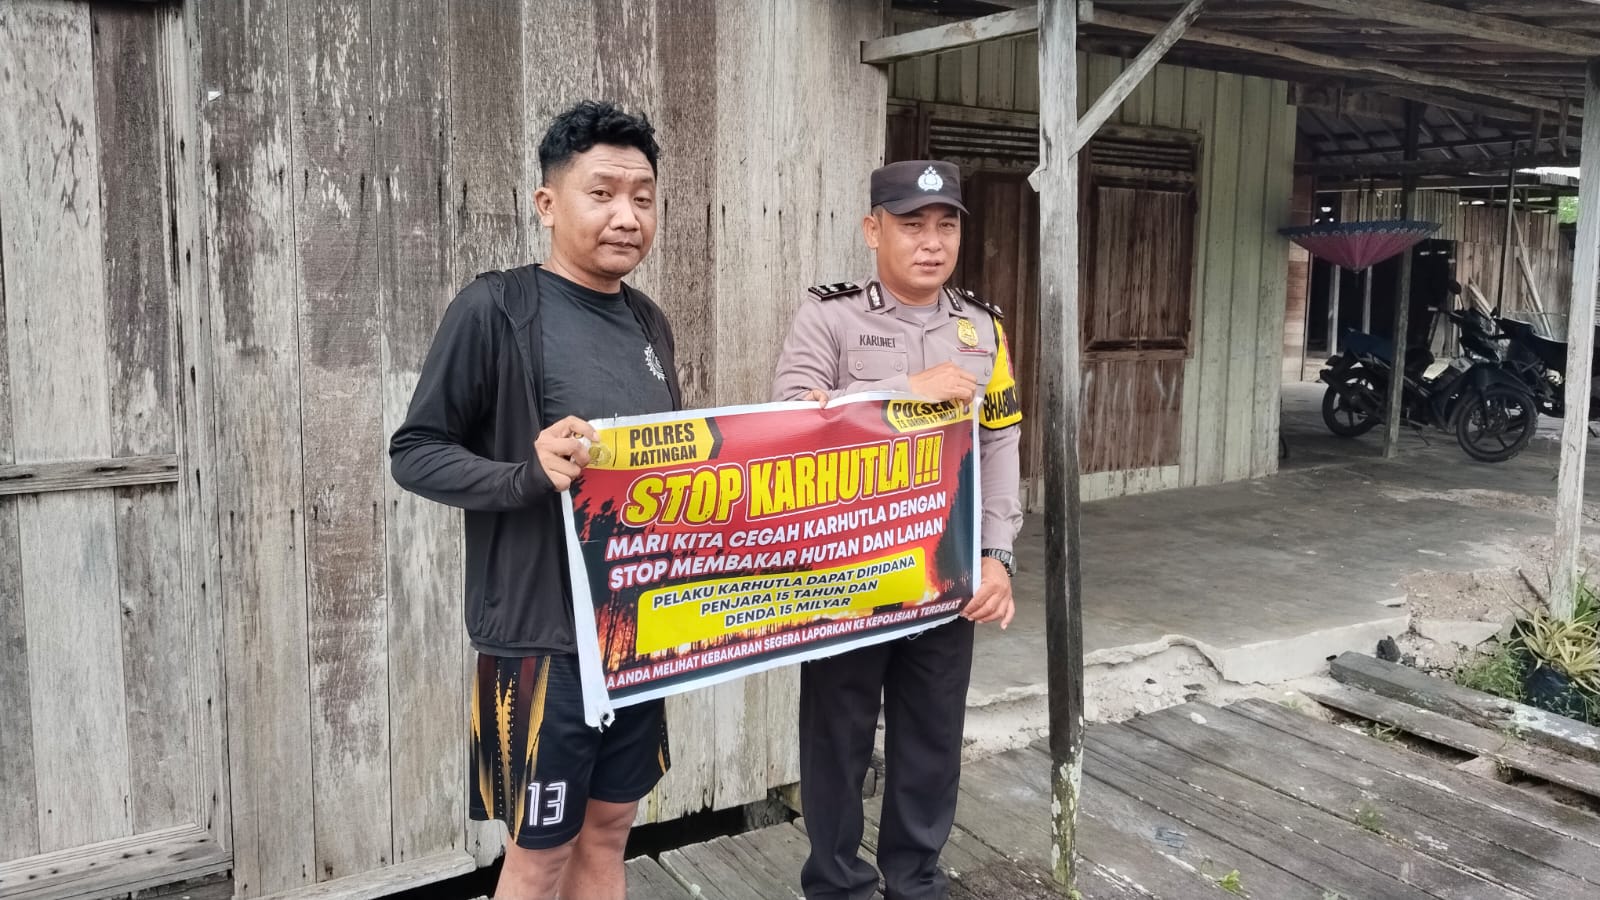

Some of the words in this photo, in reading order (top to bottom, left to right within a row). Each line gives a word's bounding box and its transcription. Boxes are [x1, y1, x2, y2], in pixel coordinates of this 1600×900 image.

[629, 422, 695, 449] POLRES
[629, 445, 697, 467] KATINGAN
[623, 465, 743, 525] STOP
[748, 440, 911, 518] KARHUTLA
[914, 434, 942, 486] !!!
[606, 533, 670, 560] MARI
[673, 531, 724, 551] KITA
[729, 523, 800, 548] CEGAH
[803, 505, 887, 540] KARHUTLA
[889, 491, 946, 517] DENGAN
[610, 560, 667, 590] STOP
[670, 549, 797, 578] MEMBAKAR
[800, 537, 860, 565] HUTAN
[862, 528, 895, 552] DAN
[896, 517, 944, 543] LAHAN
[653, 585, 715, 609] PELAKU
[718, 576, 803, 595] KARHUTLA
[806, 570, 853, 586] DAPAT
[856, 555, 916, 579] DIPIDANA
[701, 591, 772, 616] PENJARA
[776, 591, 789, 602] 15
[793, 586, 845, 599] TAHUN
[847, 580, 878, 594] DAN
[725, 605, 776, 628] DENDA
[779, 604, 792, 615] 15
[795, 597, 851, 613] MILYAR
[617, 667, 651, 686] ANDA
[652, 655, 700, 677] MELIHAT
[701, 640, 762, 666] KEBAKARAN
[764, 633, 801, 651] SEGERA
[801, 620, 853, 642] LAPORKAN
[853, 618, 865, 632] KE
[865, 608, 918, 628] KEPOLISIAN
[920, 598, 962, 616] TERDEKAT
[527, 781, 566, 827] 13
